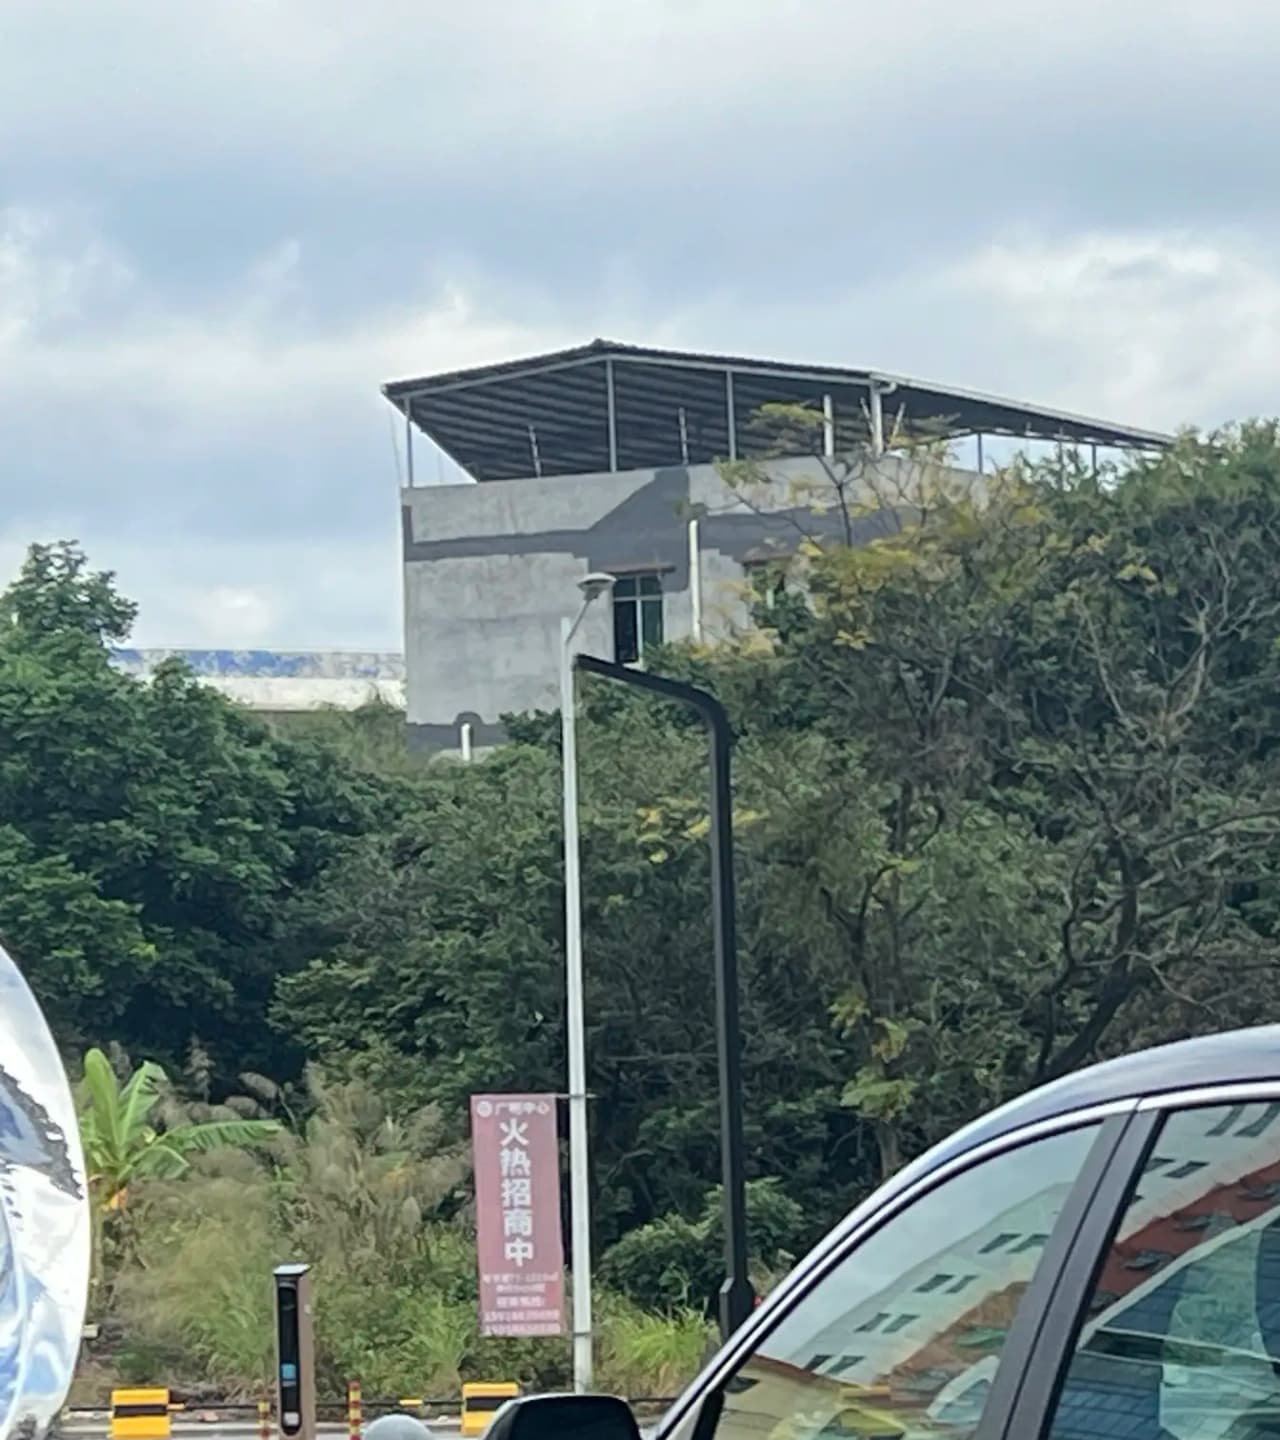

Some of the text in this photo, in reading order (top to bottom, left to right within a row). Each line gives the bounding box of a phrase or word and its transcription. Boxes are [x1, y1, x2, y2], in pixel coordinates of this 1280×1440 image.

[500, 1117, 534, 1268] 火热招商中
